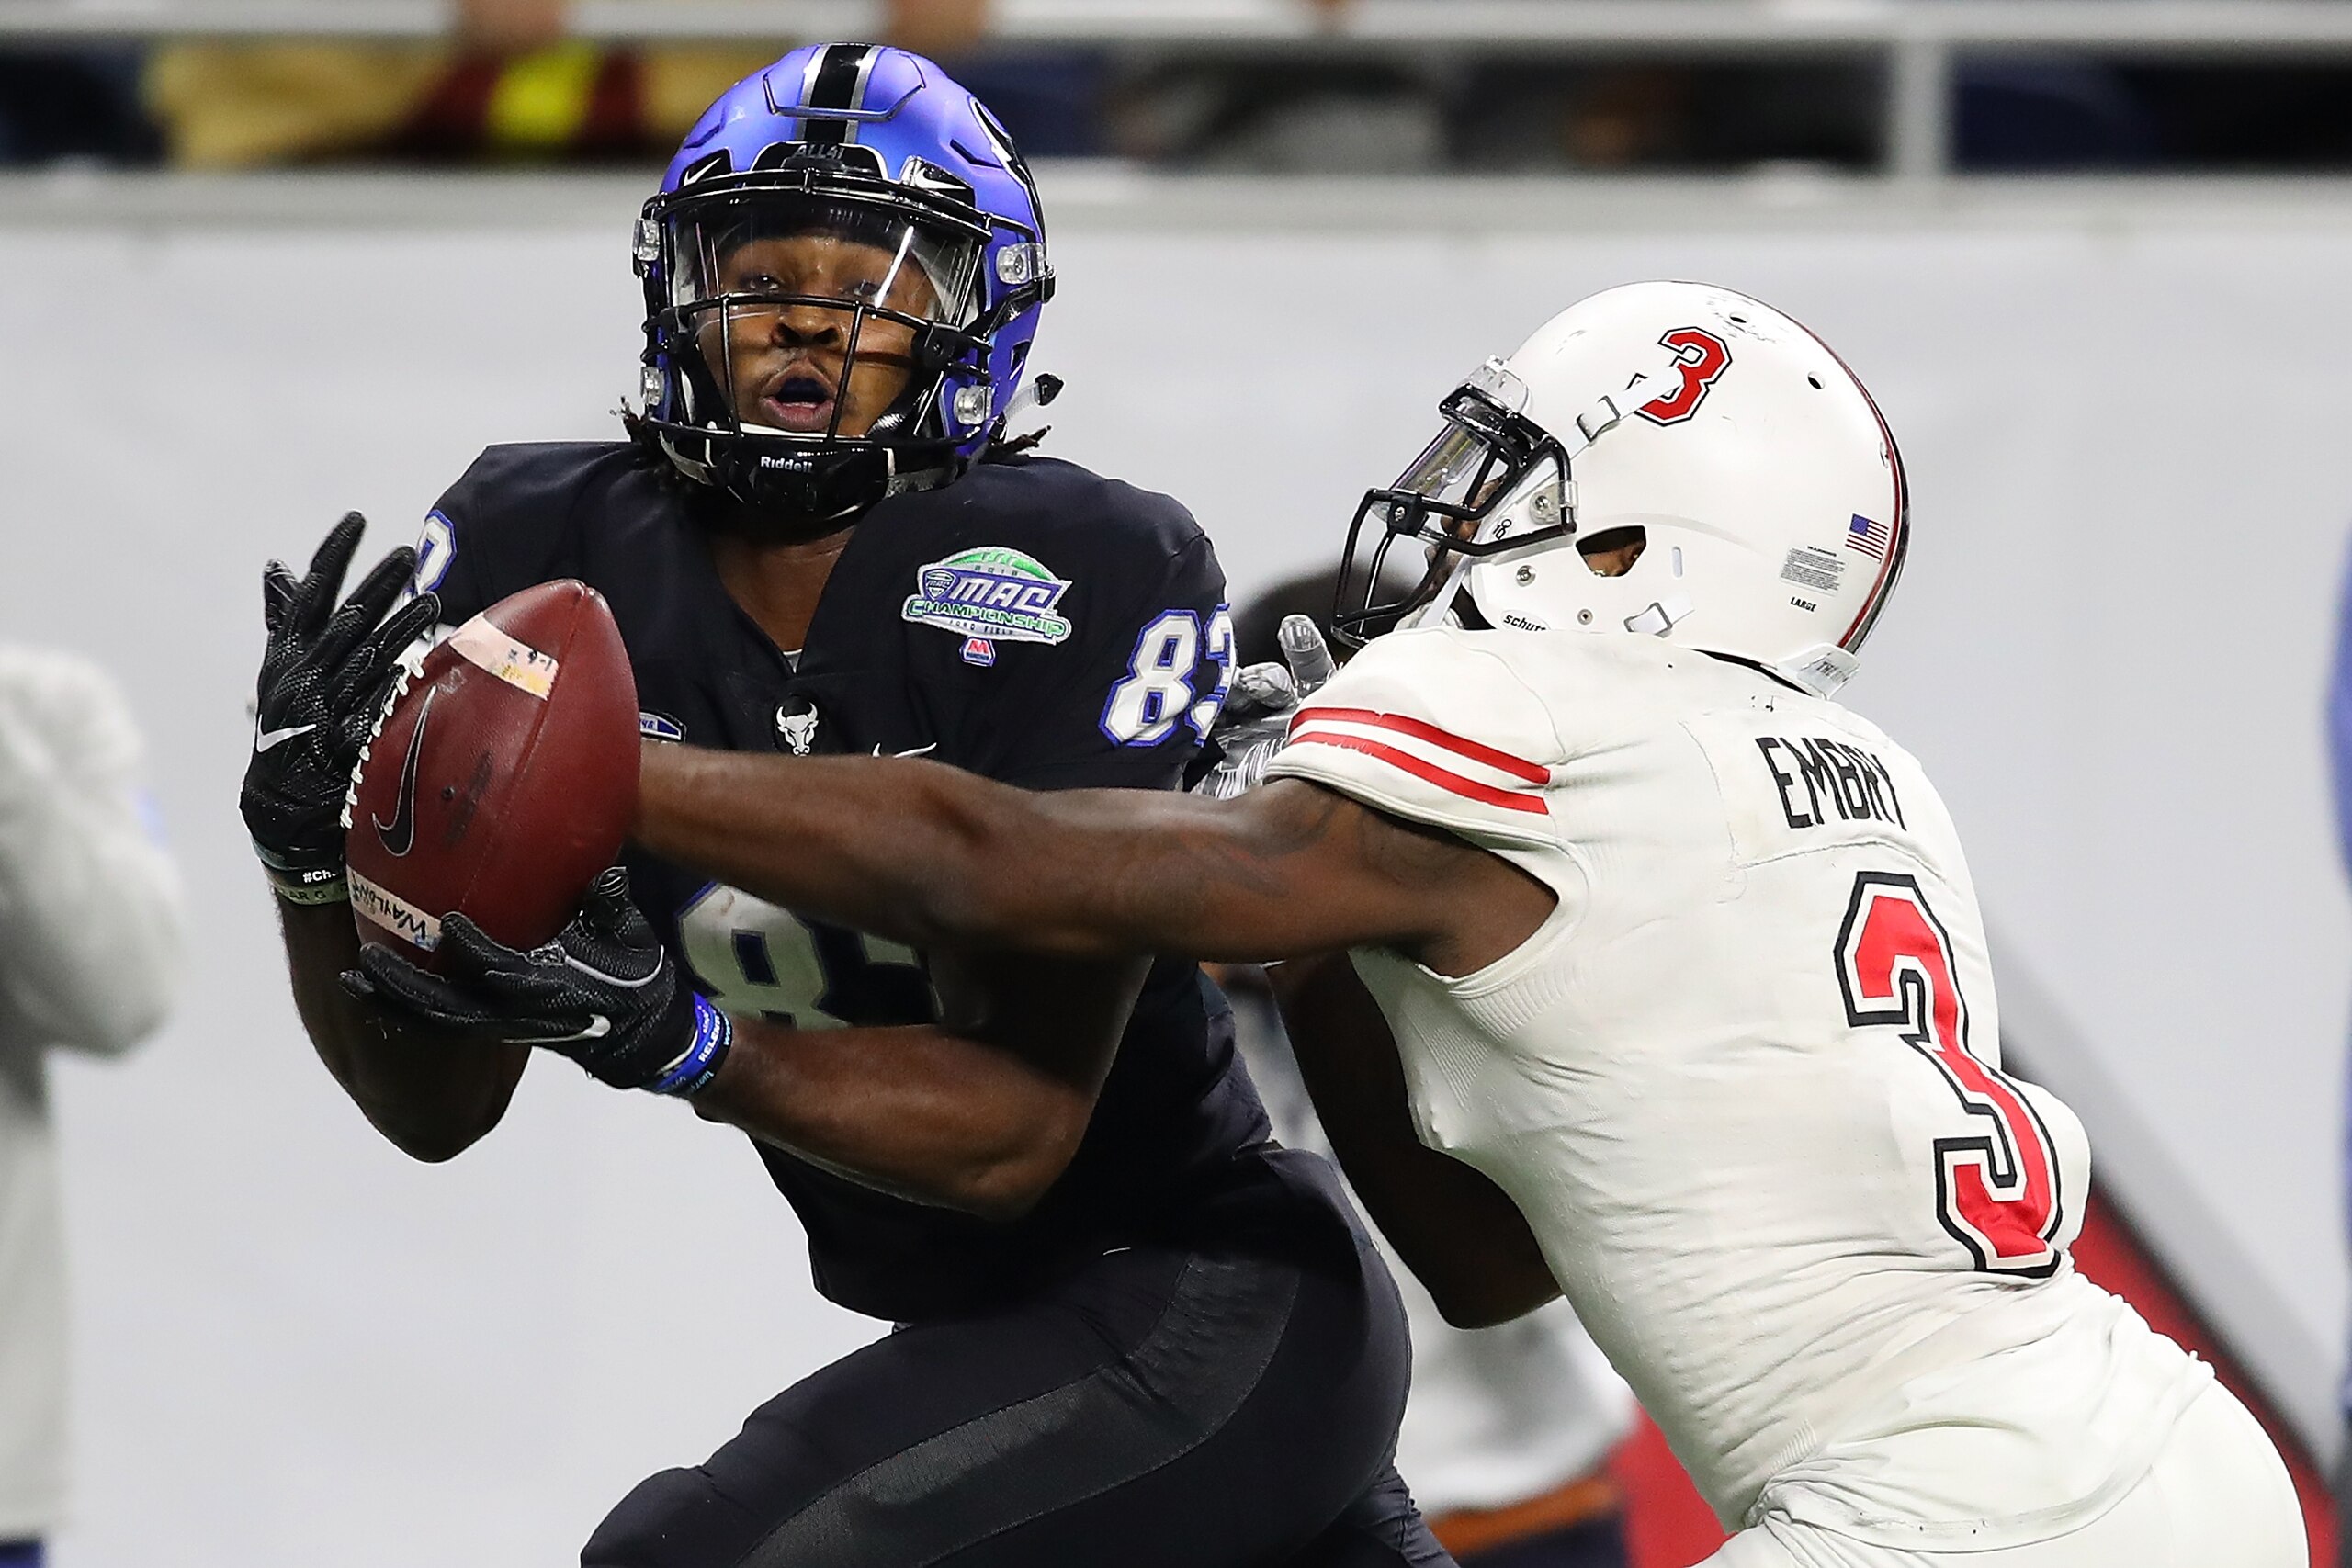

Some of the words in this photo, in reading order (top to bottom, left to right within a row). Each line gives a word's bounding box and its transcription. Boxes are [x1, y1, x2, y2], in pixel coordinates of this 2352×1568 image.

[1624, 326, 1733, 427] 3
[760, 456, 814, 473] Riddell
[948, 576, 1054, 615] MAC
[1790, 596, 1817, 613] LARGE
[908, 599, 1066, 637] CHAMPIONSHIP
[1754, 735, 1908, 832] EMBRY
[1833, 871, 2062, 1278] 3
